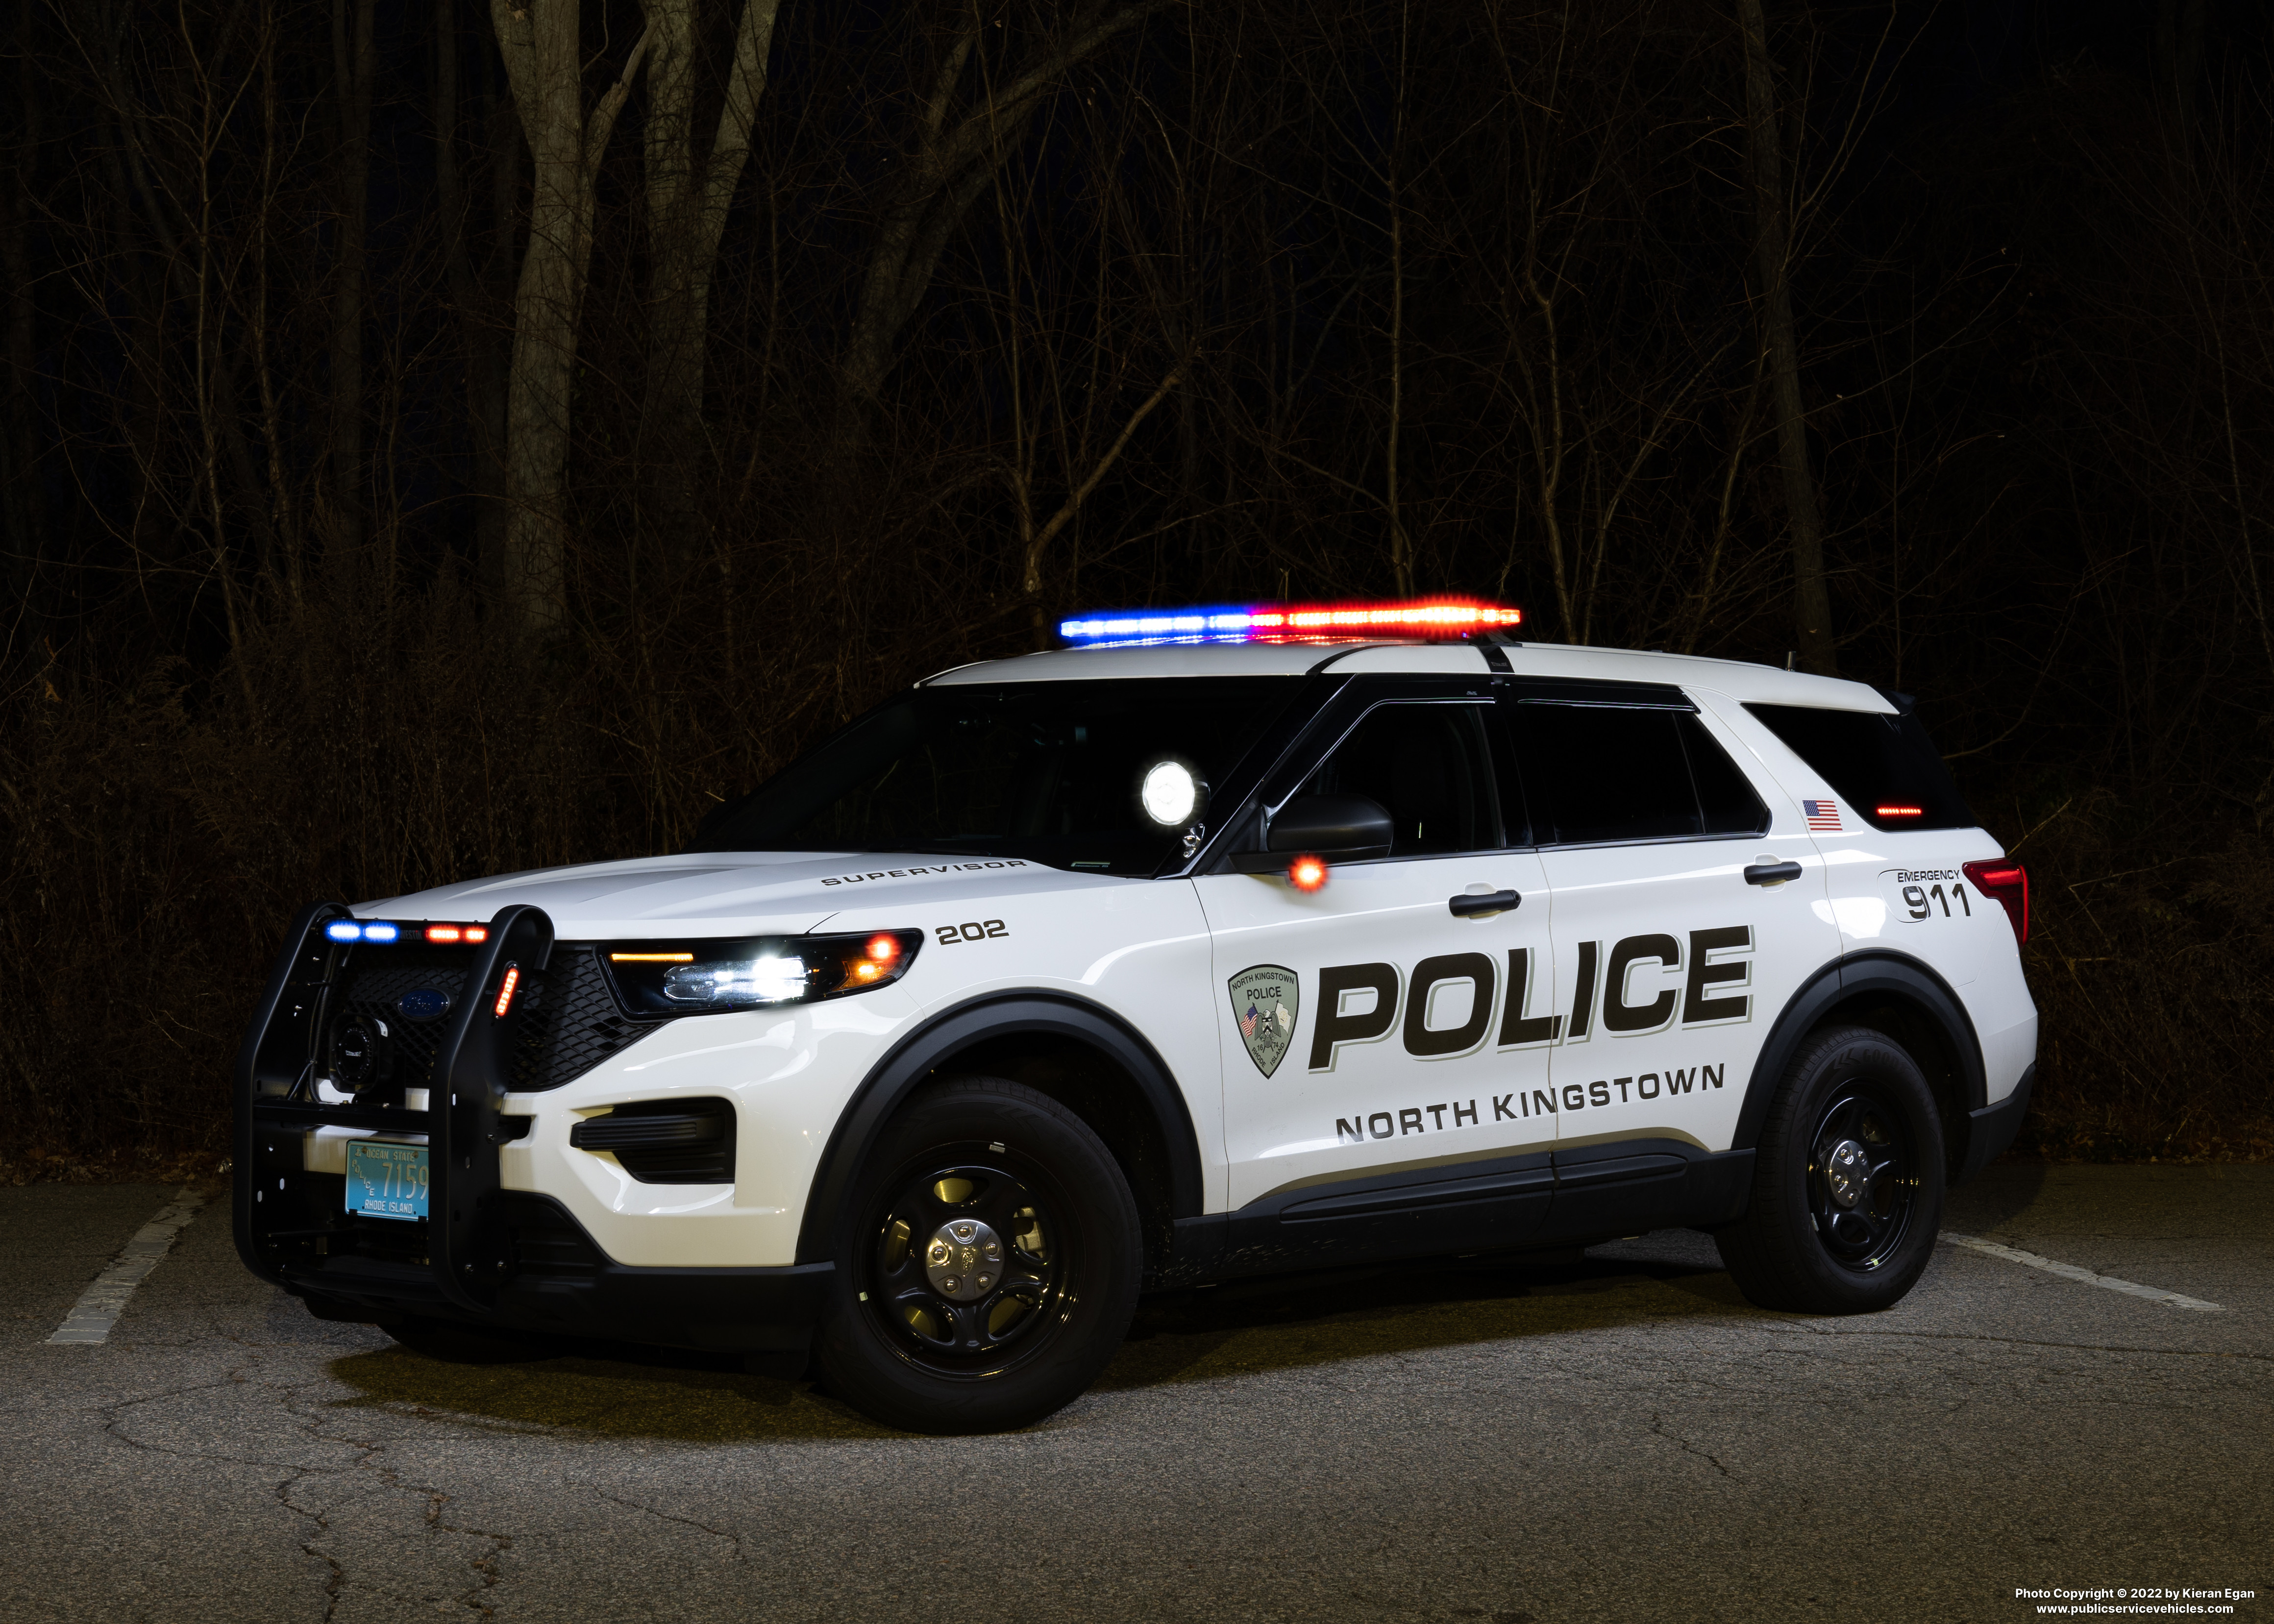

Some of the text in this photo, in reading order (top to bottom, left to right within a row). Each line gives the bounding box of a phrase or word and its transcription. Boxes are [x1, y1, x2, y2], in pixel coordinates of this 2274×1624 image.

[821, 861, 1027, 886] SUPERVISOR
[1898, 870, 1960, 882] EMERGENCY
[1902, 884, 1971, 919] 911
[935, 919, 1009, 945] 202
[1232, 972, 1294, 991] NORTH KINGSTOWN
[1246, 986, 1282, 1001] POLICE
[1308, 925, 1755, 1074] POLICE
[1252, 1047, 1266, 1068] RHODE
[1270, 1042, 1285, 1066] ISLAND
[1336, 1063, 1725, 1145] NORTH KINGSTOWN
[366, 1148, 415, 1162] OCEAN STATE
[351, 1159, 374, 1197] POLICE
[382, 1162, 428, 1201] 7159
[364, 1199, 413, 1215] RHODE ISLAND
